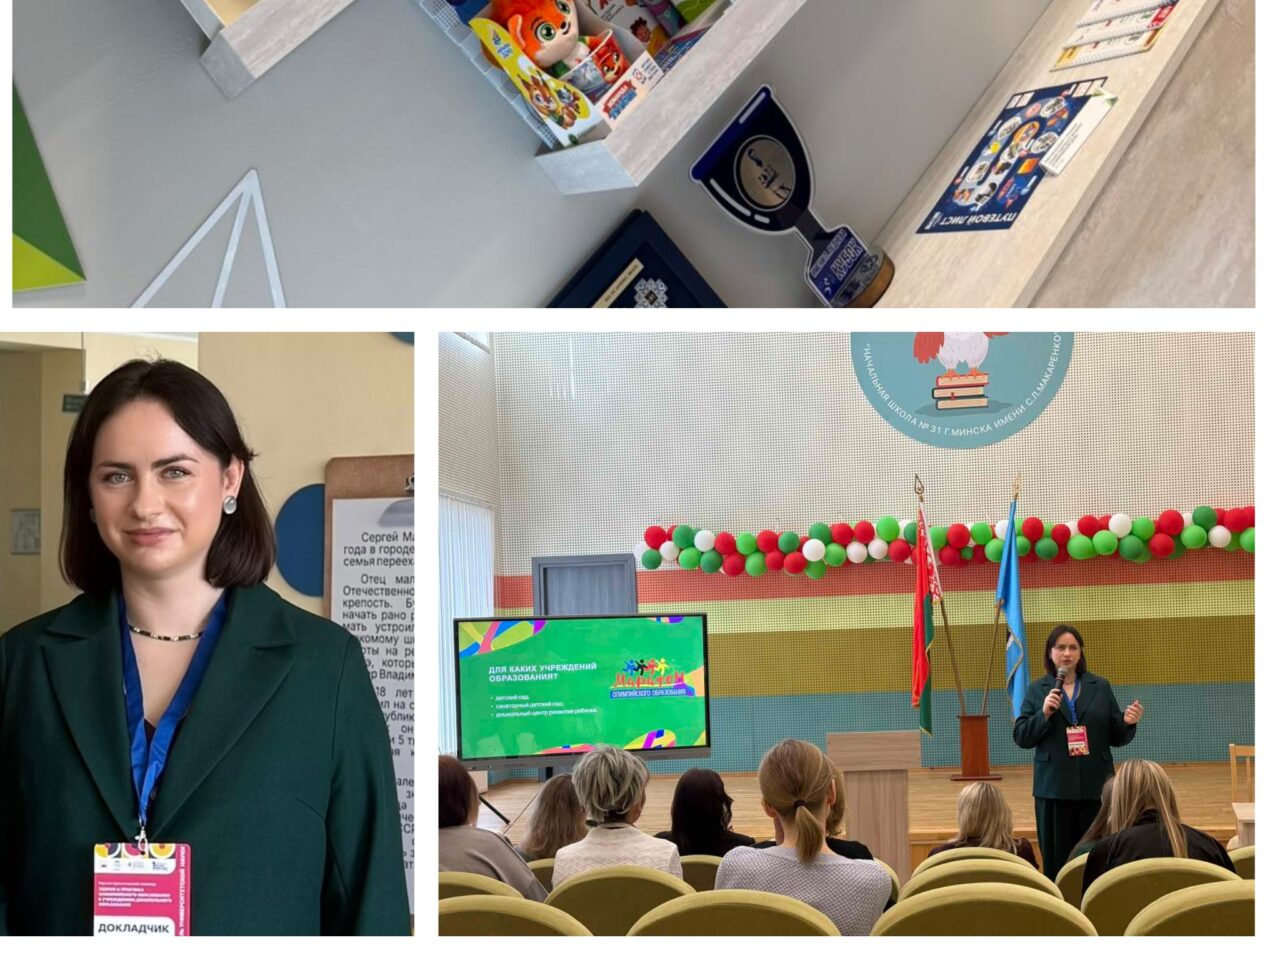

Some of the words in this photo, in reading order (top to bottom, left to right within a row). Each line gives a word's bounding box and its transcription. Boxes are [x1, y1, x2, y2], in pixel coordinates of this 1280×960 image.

[938, 215, 967, 225] ЛИСТ
[967, 211, 1016, 225] ПУТЕВОЙ
[888, 400, 917, 426] ШКОЛА
[931, 424, 942, 434] 31
[944, 424, 992, 437] Г.МИНСКА
[994, 405, 1026, 429] ИМЕНИ
[361, 531, 398, 544] Сергей
[344, 546, 366, 556] года
[370, 546, 376, 554] в
[379, 545, 414, 556] городе
[343, 557, 375, 567] семья
[361, 574, 386, 585] Отец
[342, 598, 393, 610] крепость.
[342, 611, 377, 620] начать
[381, 611, 406, 622] рано
[386, 647, 398, 656] на
[488, 666, 507, 674] ДЛЯ
[509, 665, 537, 673] КАКИХ
[539, 662, 597, 672] УЧРЕЖДЕНИЙ
[488, 672, 558, 683] ОБРАЗОВАНИЯ?
[613, 671, 685, 689] Марафон
[396, 689, 413, 698] лет
[612, 689, 651, 698] ОЛИМПИЙСКОГО
[393, 701, 406, 709] на
[399, 735, 405, 745] 5
[98, 924, 169, 933] ДОКЛАДЧИК
